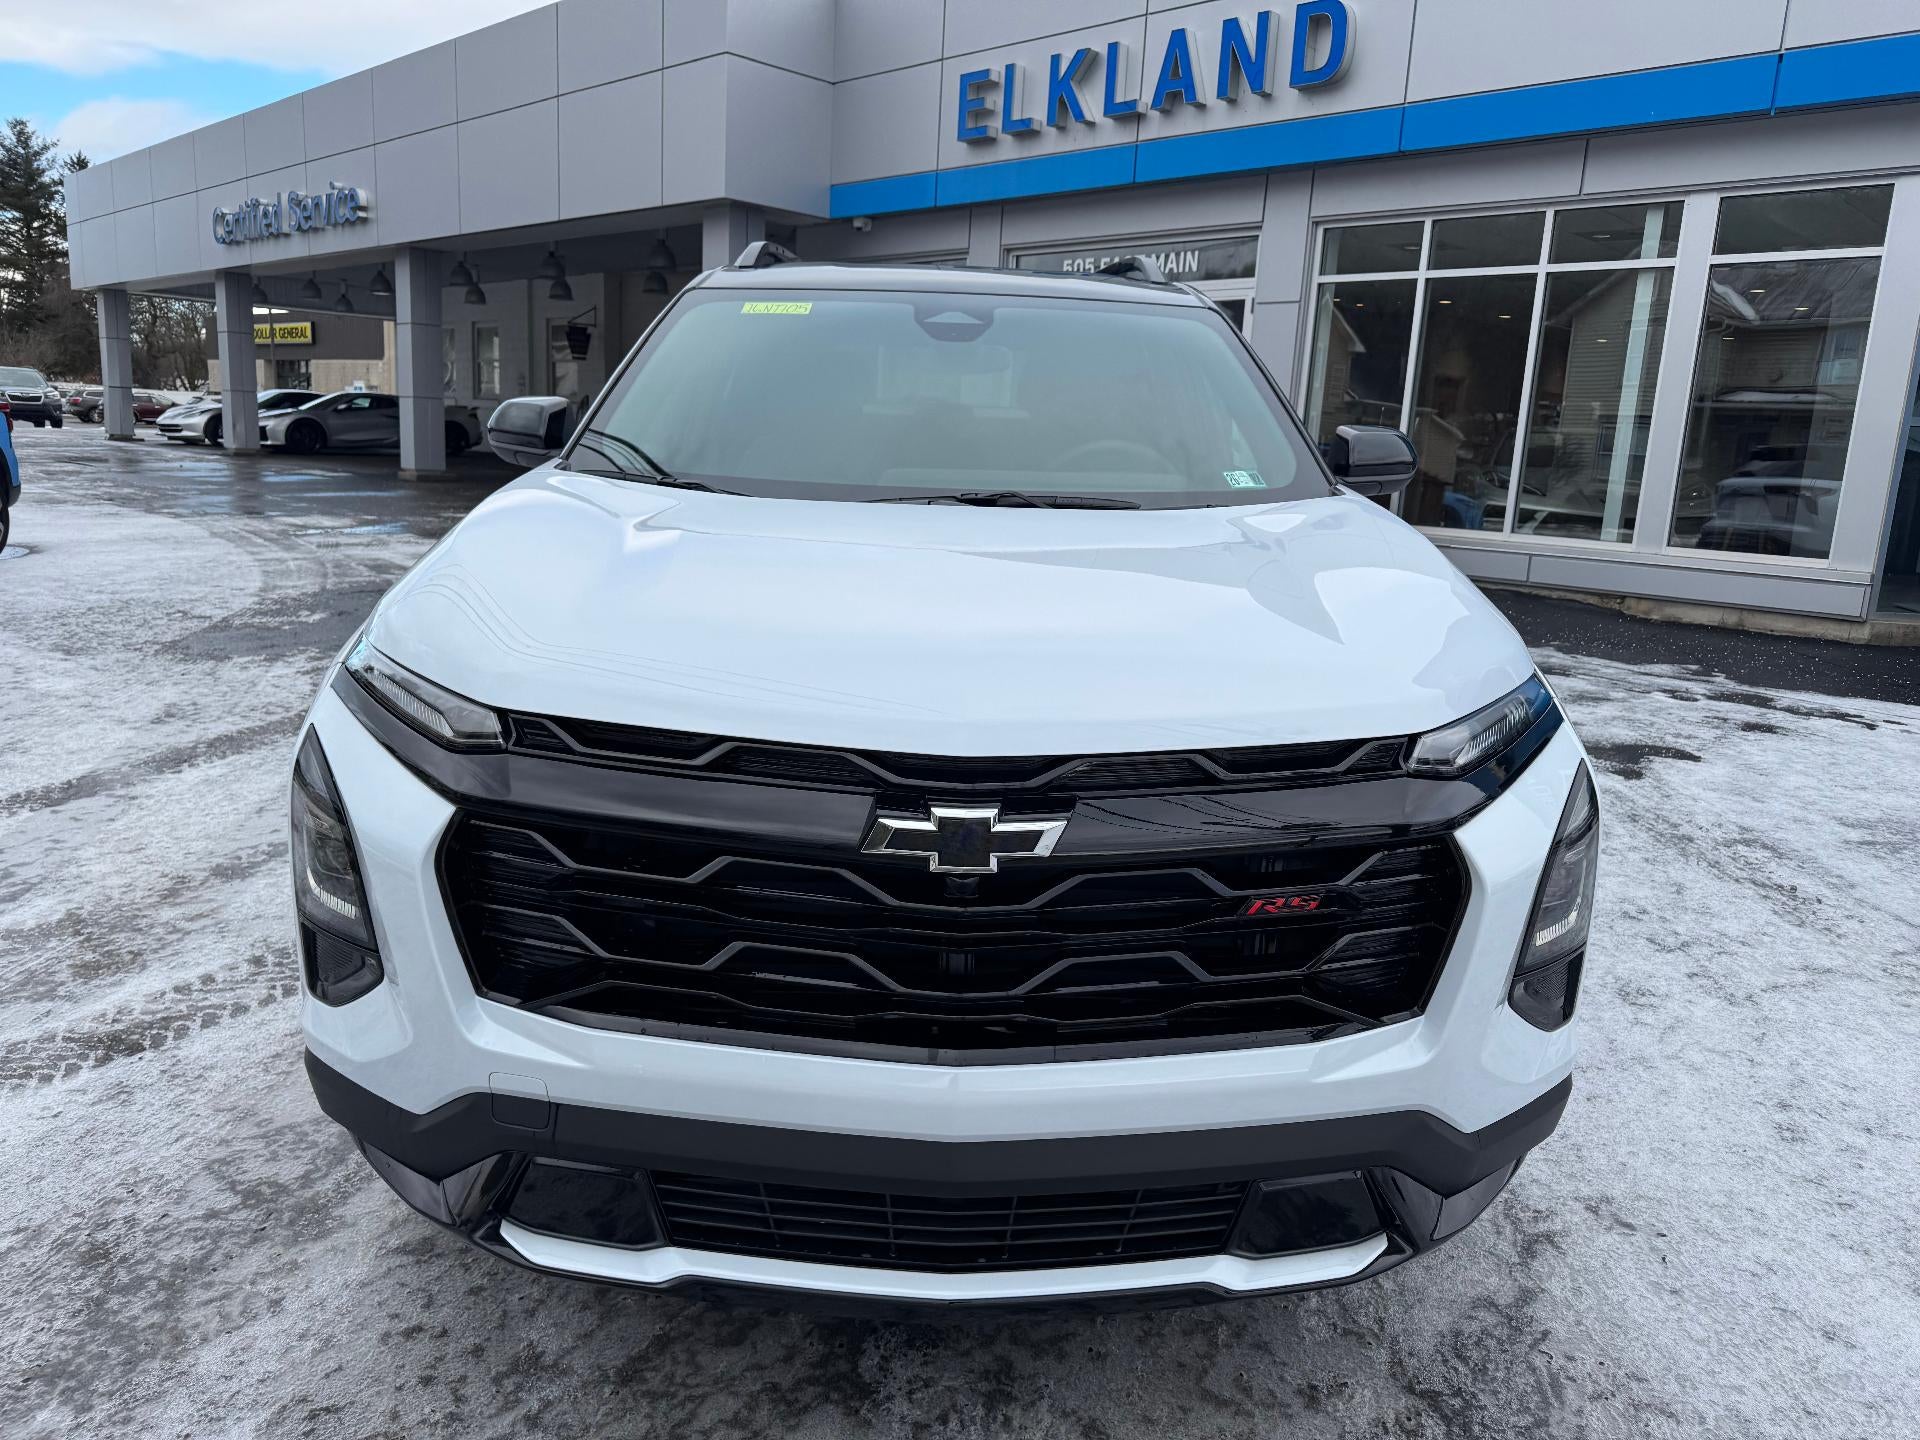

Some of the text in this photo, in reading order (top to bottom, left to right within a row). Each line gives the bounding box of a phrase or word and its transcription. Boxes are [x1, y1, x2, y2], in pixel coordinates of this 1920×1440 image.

[957, 0, 1354, 143] ELKLAND
[213, 181, 363, 244] Certified Service
[1153, 250, 1199, 274] MAIN
[279, 326, 308, 339] GENERAL
[1246, 895, 1321, 916] RS
